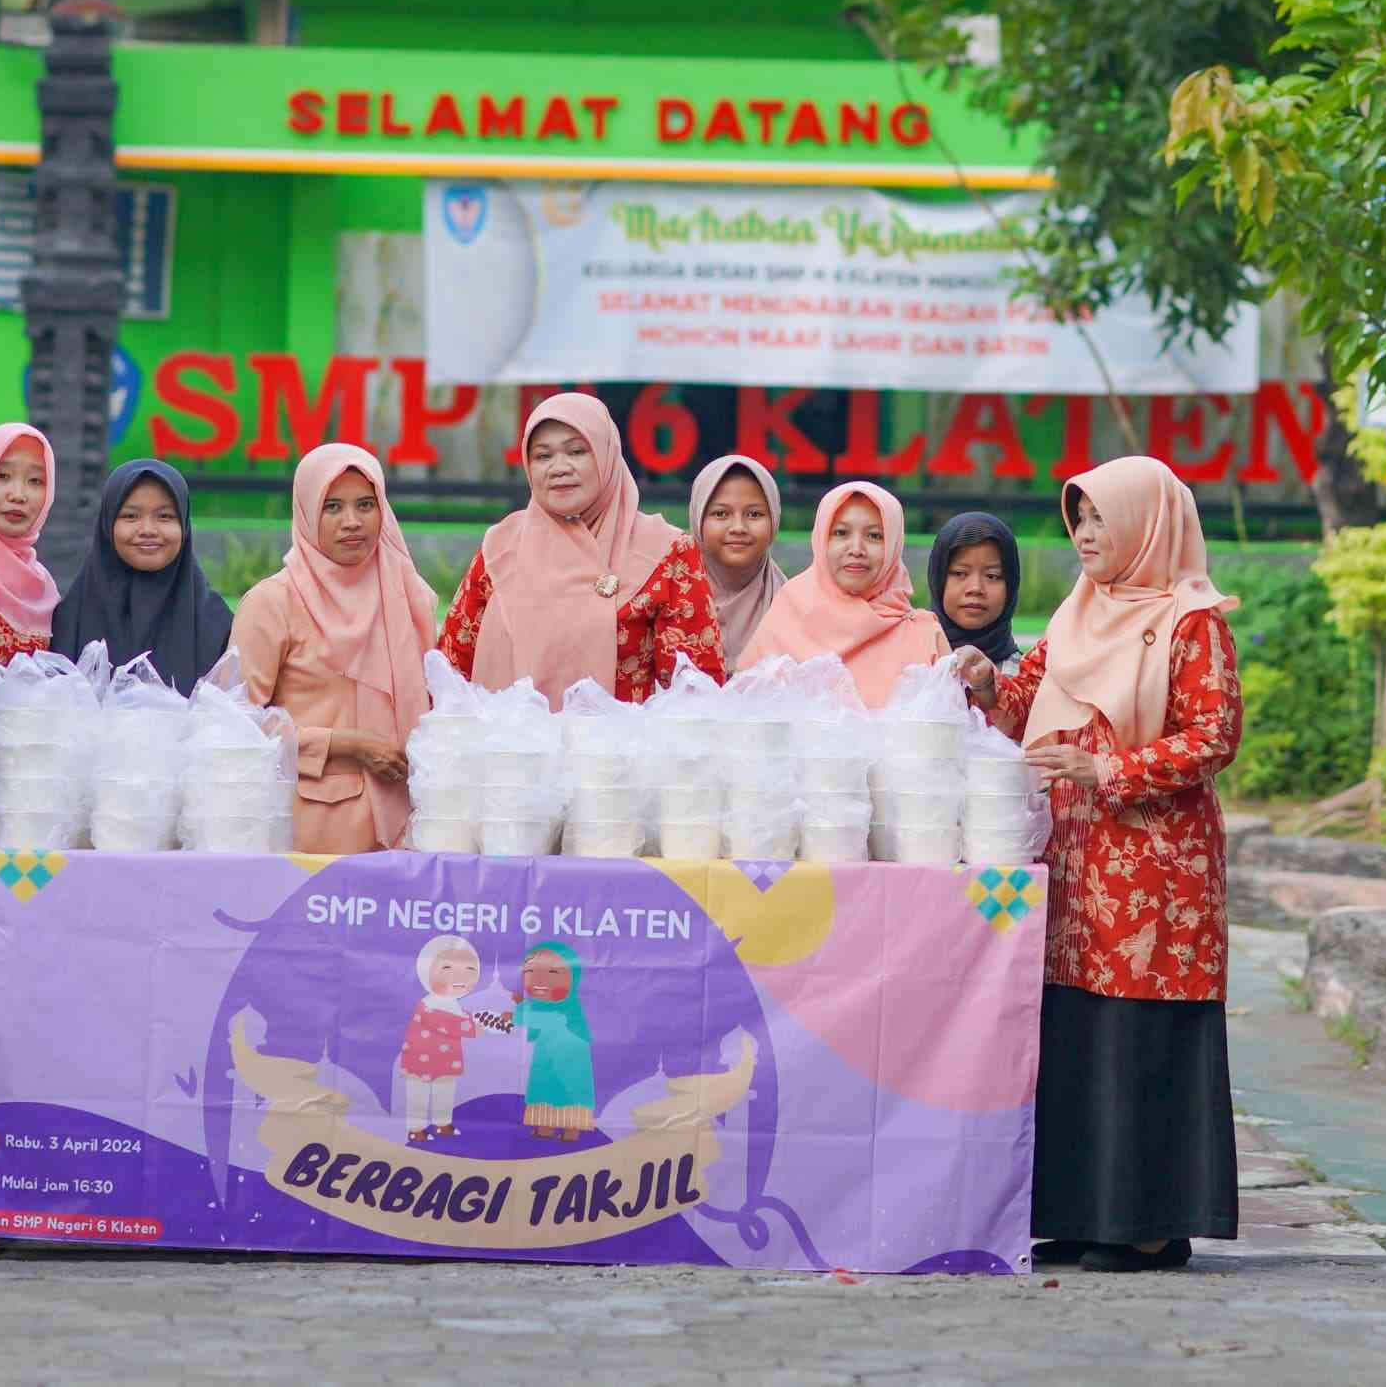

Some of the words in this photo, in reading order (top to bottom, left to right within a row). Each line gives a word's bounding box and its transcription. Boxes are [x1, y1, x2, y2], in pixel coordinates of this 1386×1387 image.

[286, 90, 619, 141] SELAMAT
[657, 98, 932, 147] DATANG
[597, 290, 710, 313] SELAMAT
[637, 325, 740, 347] MOHON
[149, 349, 479, 465] SMP
[630, 381, 699, 473] 6
[733, 380, 1326, 486] KLATEN
[307, 894, 377, 927] SMP
[388, 899, 508, 934] NEGERI
[520, 906, 542, 935] 6
[553, 907, 690, 939] KLATEN
[49, 1136, 59, 1150] 3
[63, 1138, 98, 1155] April
[103, 1139, 142, 1153] 2024
[1, 1175, 38, 1191] Mulai
[42, 1177, 69, 1193] jam
[73, 1179, 113, 1194] 16:30
[283, 1142, 512, 1224] BERBAGI
[529, 1154, 700, 1226] TAKJIL
[13, 1214, 43, 1229] SMP
[47, 1217, 93, 1234] Negeri
[97, 1219, 107, 1233] 6
[111, 1219, 157, 1235] Klaten
